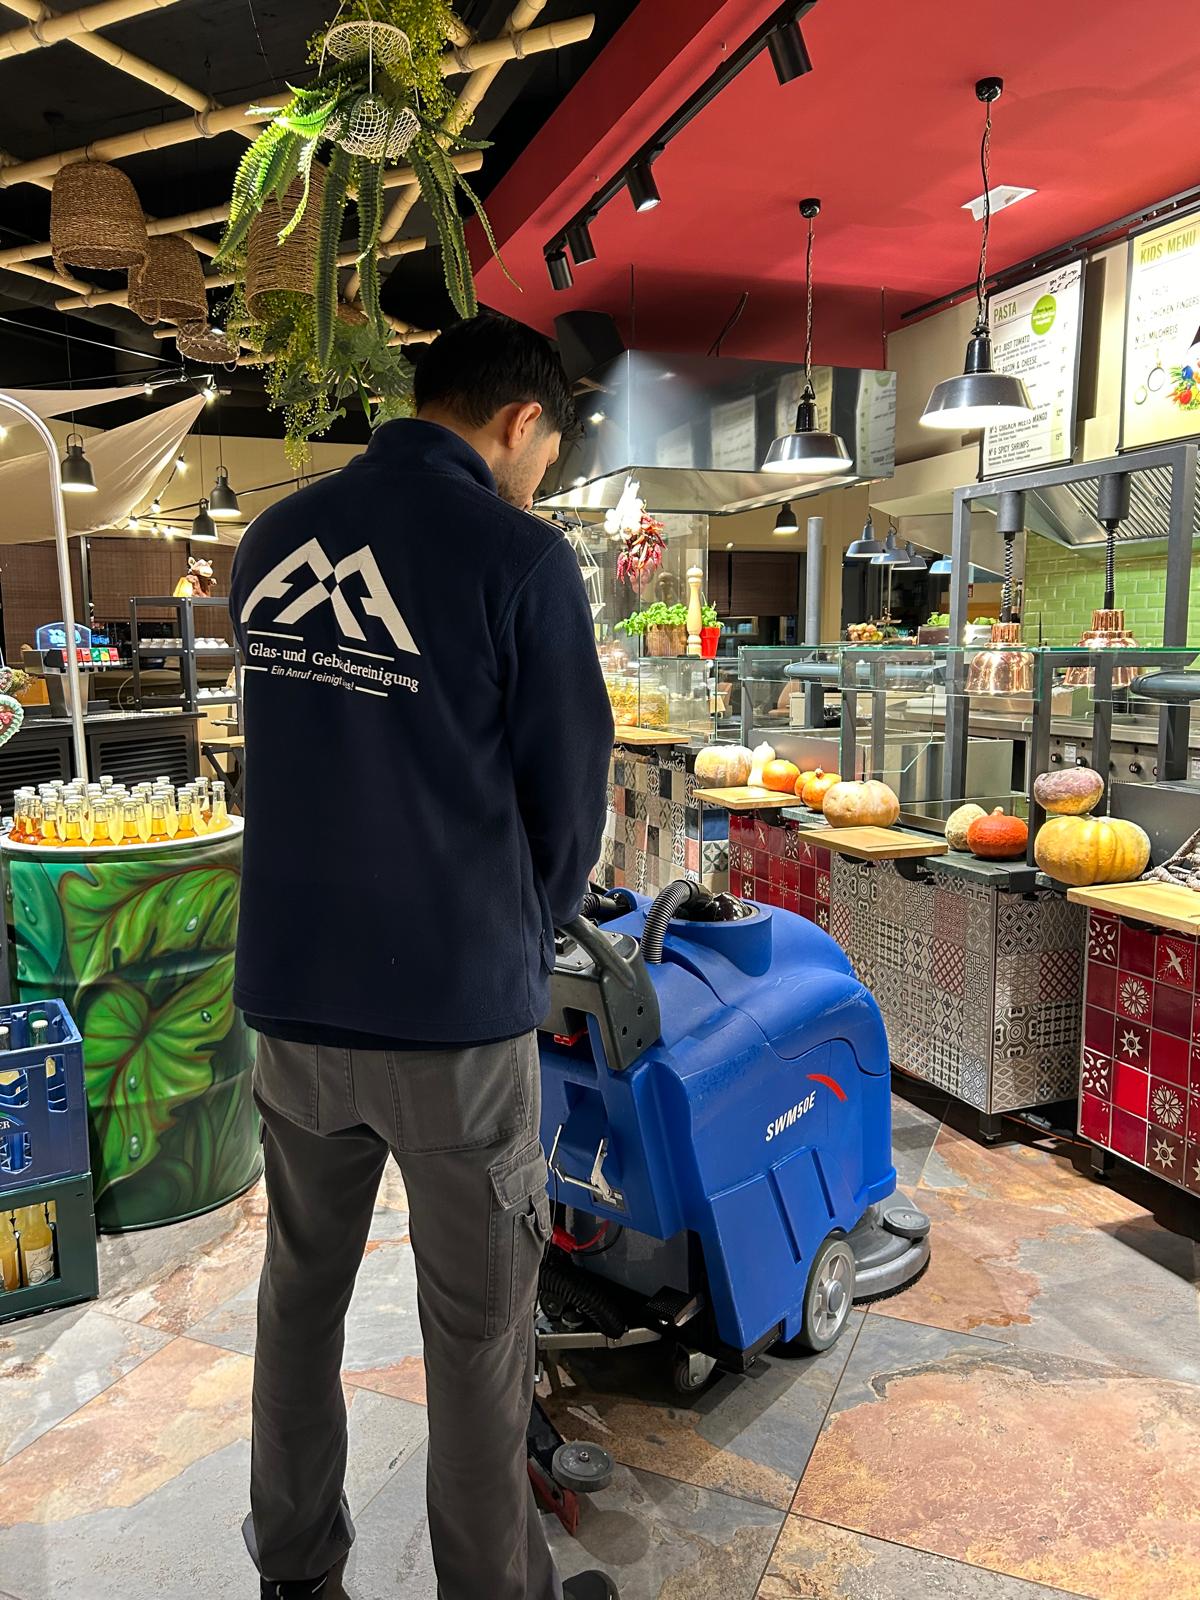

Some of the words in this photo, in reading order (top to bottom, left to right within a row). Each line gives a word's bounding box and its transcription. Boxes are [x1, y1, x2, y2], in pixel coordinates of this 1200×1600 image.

[1140, 243, 1163, 265] KIDS
[1167, 229, 1197, 255] MENU
[993, 302, 1017, 323] PASTA
[1002, 340, 1013, 352] JUST
[1013, 334, 1031, 350] TOMATO
[1002, 361, 1015, 374] BACON
[1021, 355, 1038, 368] CHEESE
[1032, 411, 1048, 423] MANGO
[997, 443, 1010, 455] SPICY
[1010, 439, 1030, 451] SHRIMPS
[270, 665, 285, 676] Ein
[285, 667, 313, 680] Anruf
[312, 672, 343, 687] reinigt
[312, 651, 419, 693] Gebdereinigung
[765, 1090, 816, 1142] SWM50E
